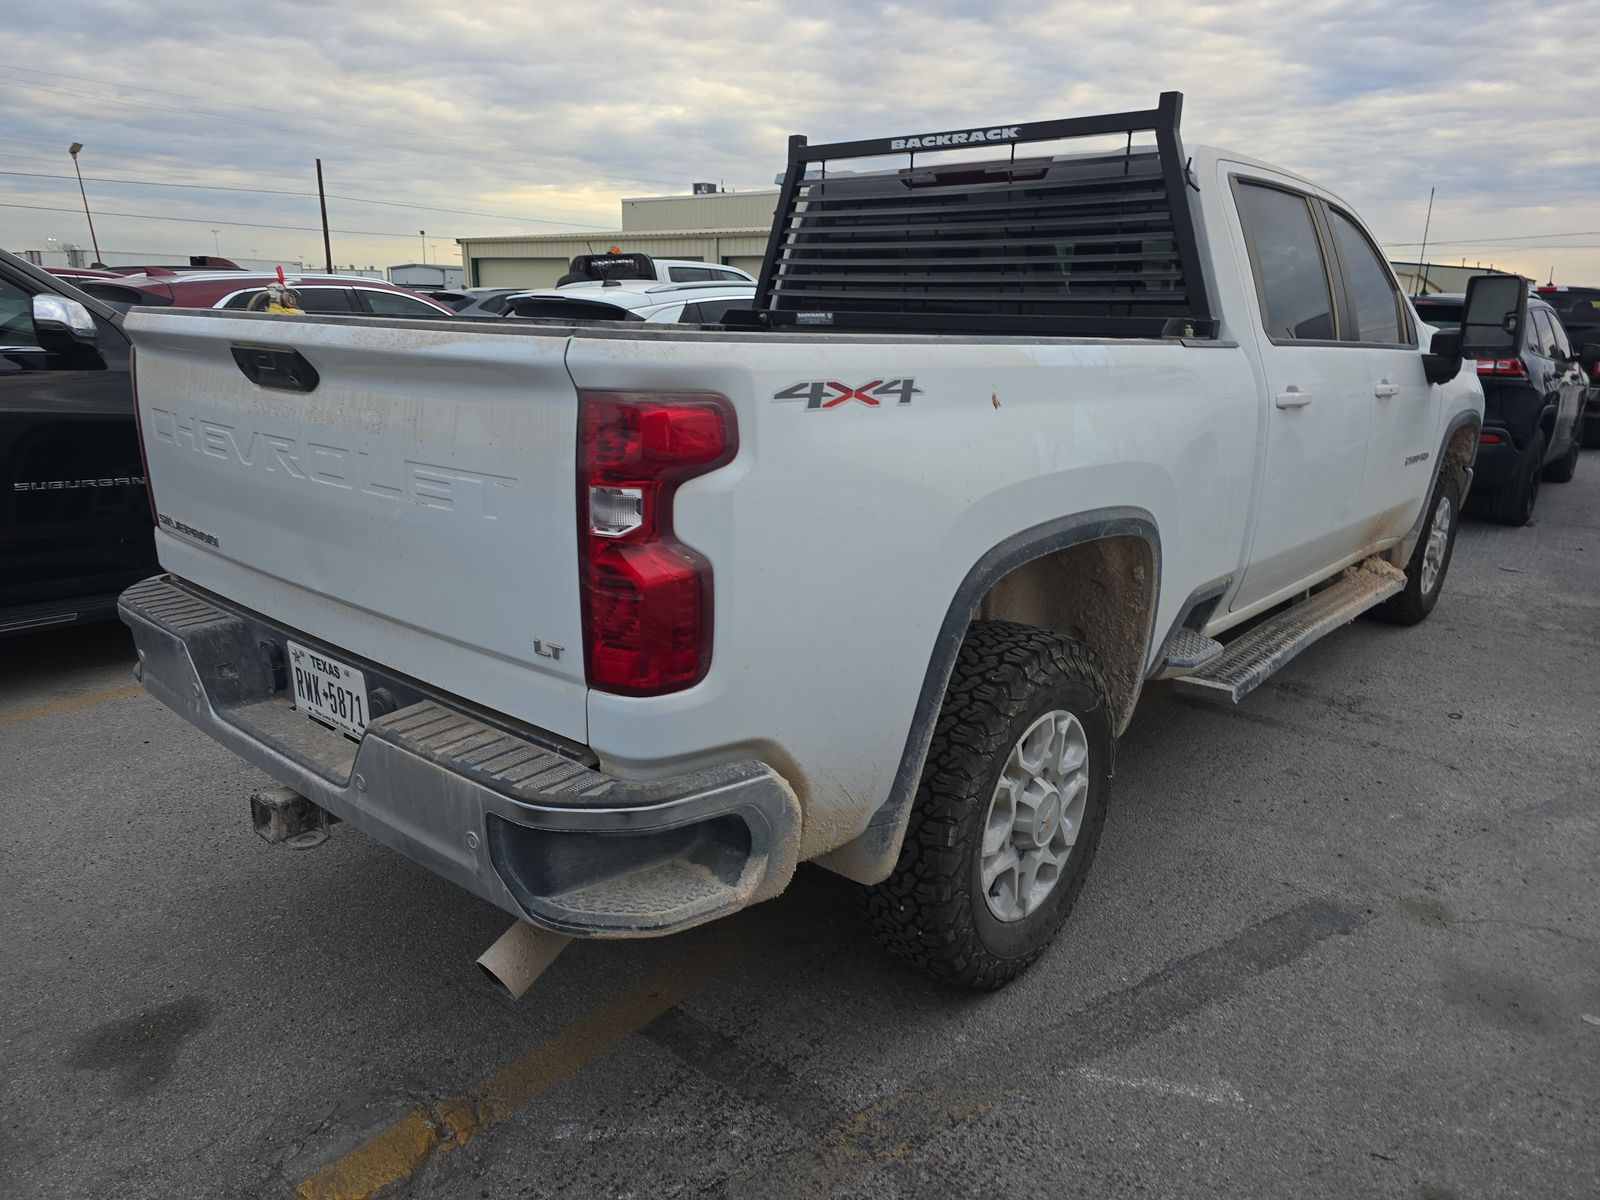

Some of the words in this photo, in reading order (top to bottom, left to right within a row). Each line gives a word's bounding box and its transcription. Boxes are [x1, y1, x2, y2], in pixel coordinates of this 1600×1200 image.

[890, 127, 1019, 150] BACKRACK
[151, 406, 518, 520] CHEVROLET
[13, 476, 146, 491] SUBURBAN
[533, 638, 566, 661] LT
[309, 654, 341, 680] TEXAS
